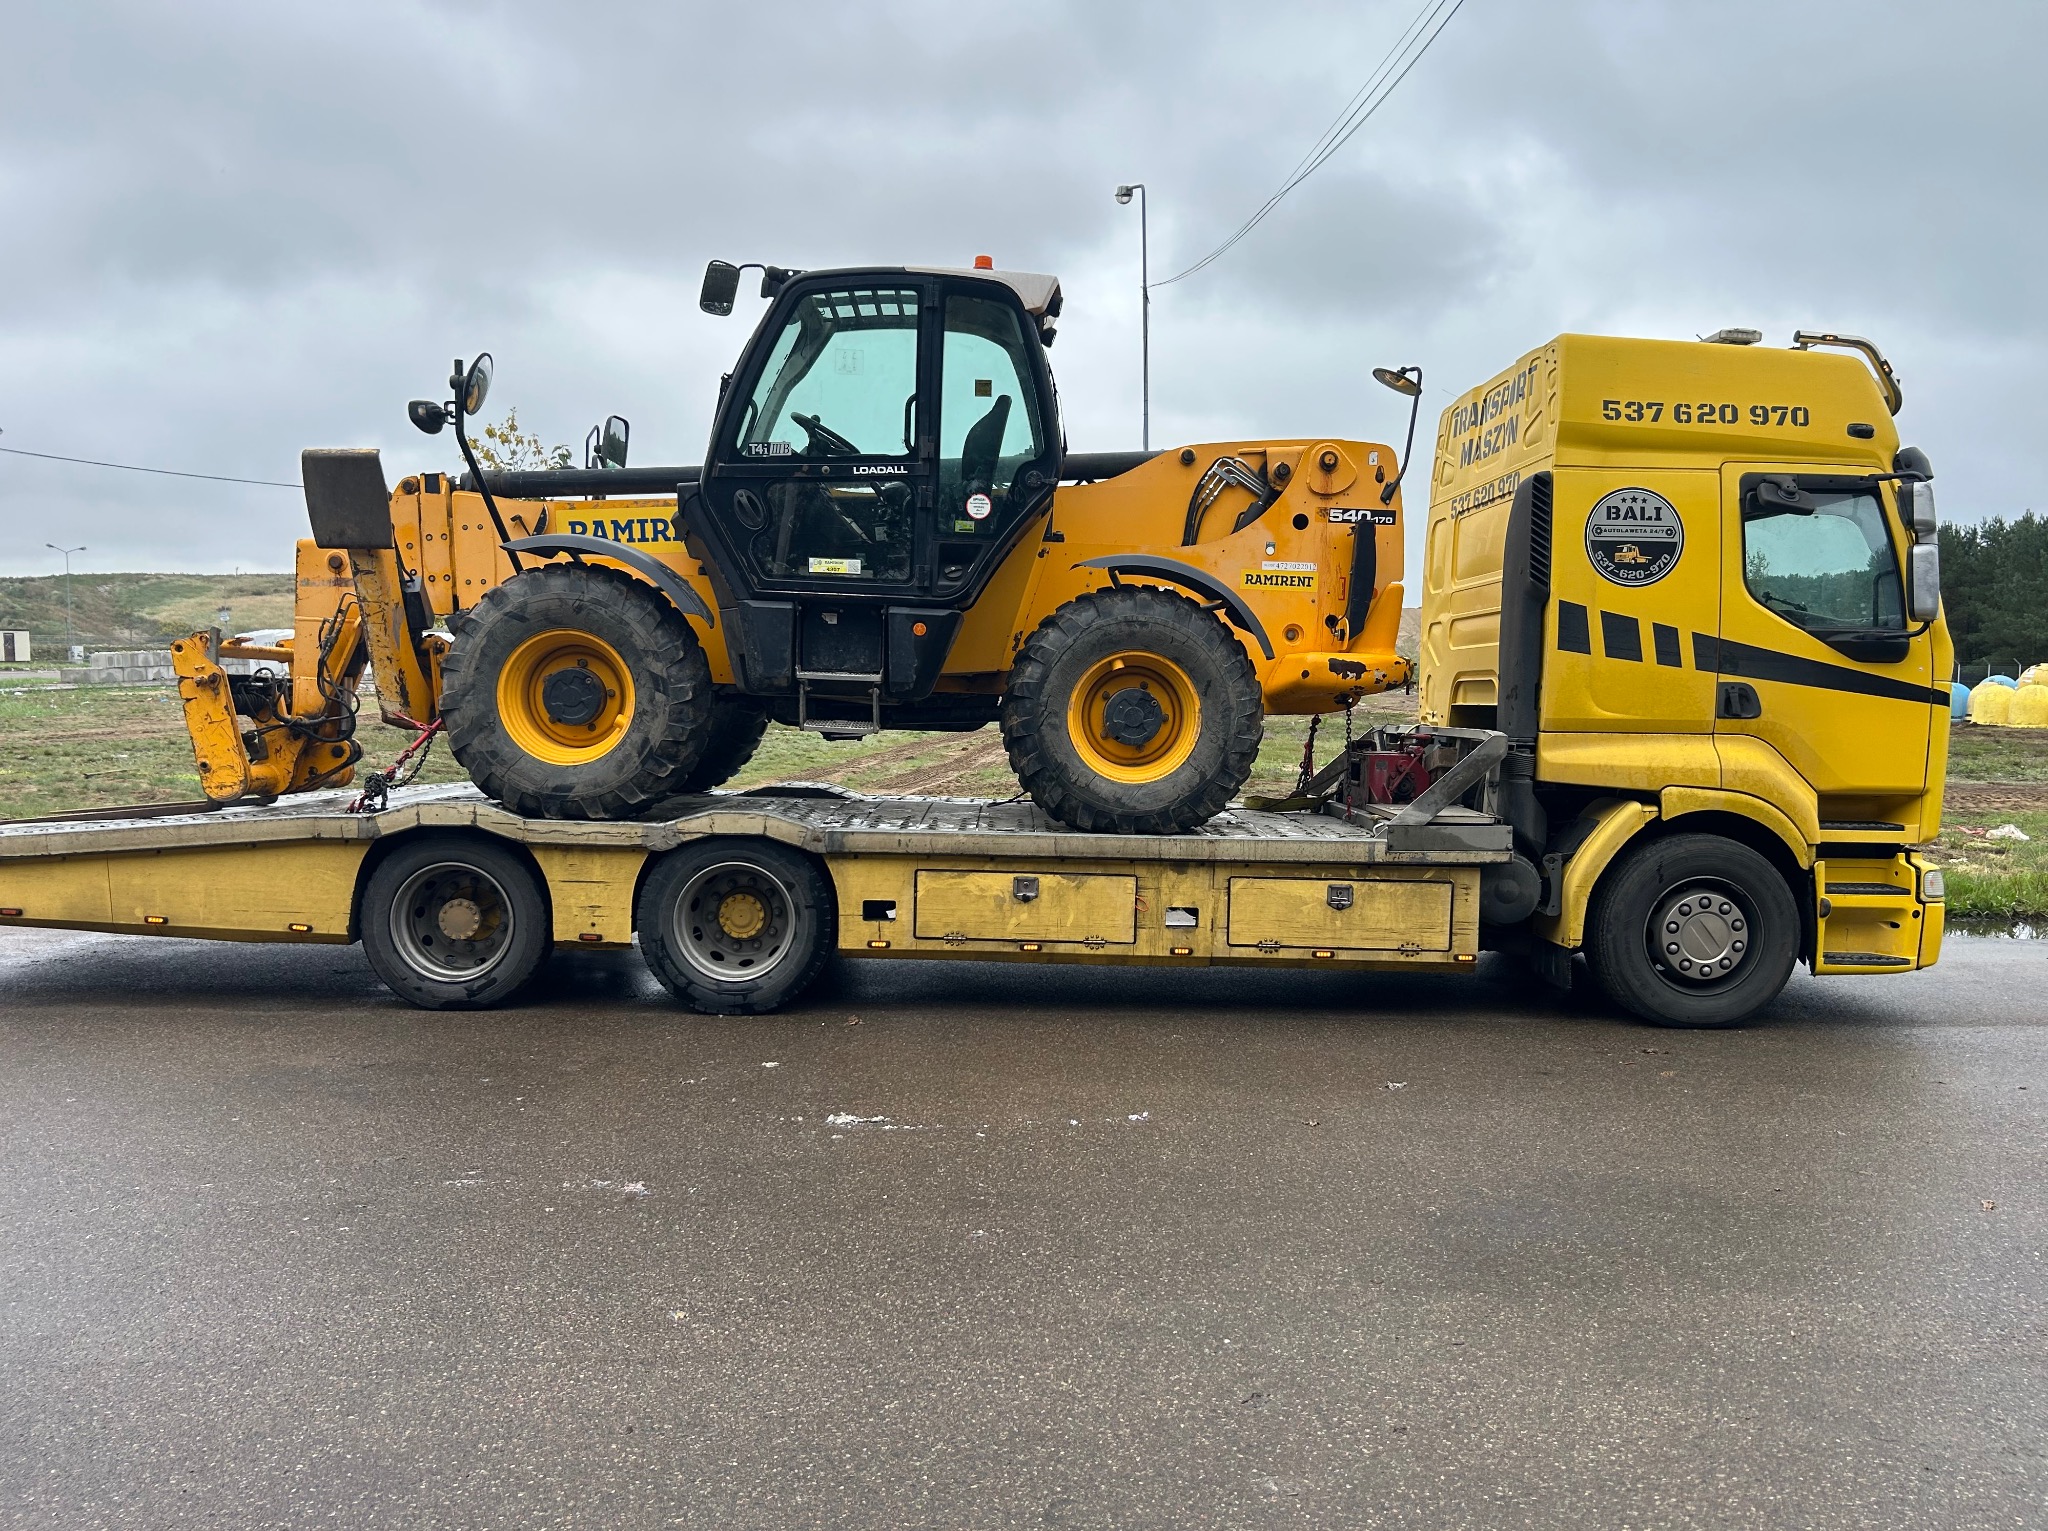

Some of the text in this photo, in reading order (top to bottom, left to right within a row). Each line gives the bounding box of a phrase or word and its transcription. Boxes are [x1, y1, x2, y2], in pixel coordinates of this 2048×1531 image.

[1452, 363, 1538, 438] TRANSPORT
[1602, 399, 1810, 427] 537 620 970
[1459, 413, 1519, 469] MASZYN
[853, 465, 908, 475] LOADALL
[1450, 471, 1521, 520] 537 620 970
[1606, 505, 1663, 521] BALI
[568, 518, 682, 543] RAMIR
[1595, 550, 1671, 580] 537-620-970
[1245, 573, 1314, 588] RAMIRENT
